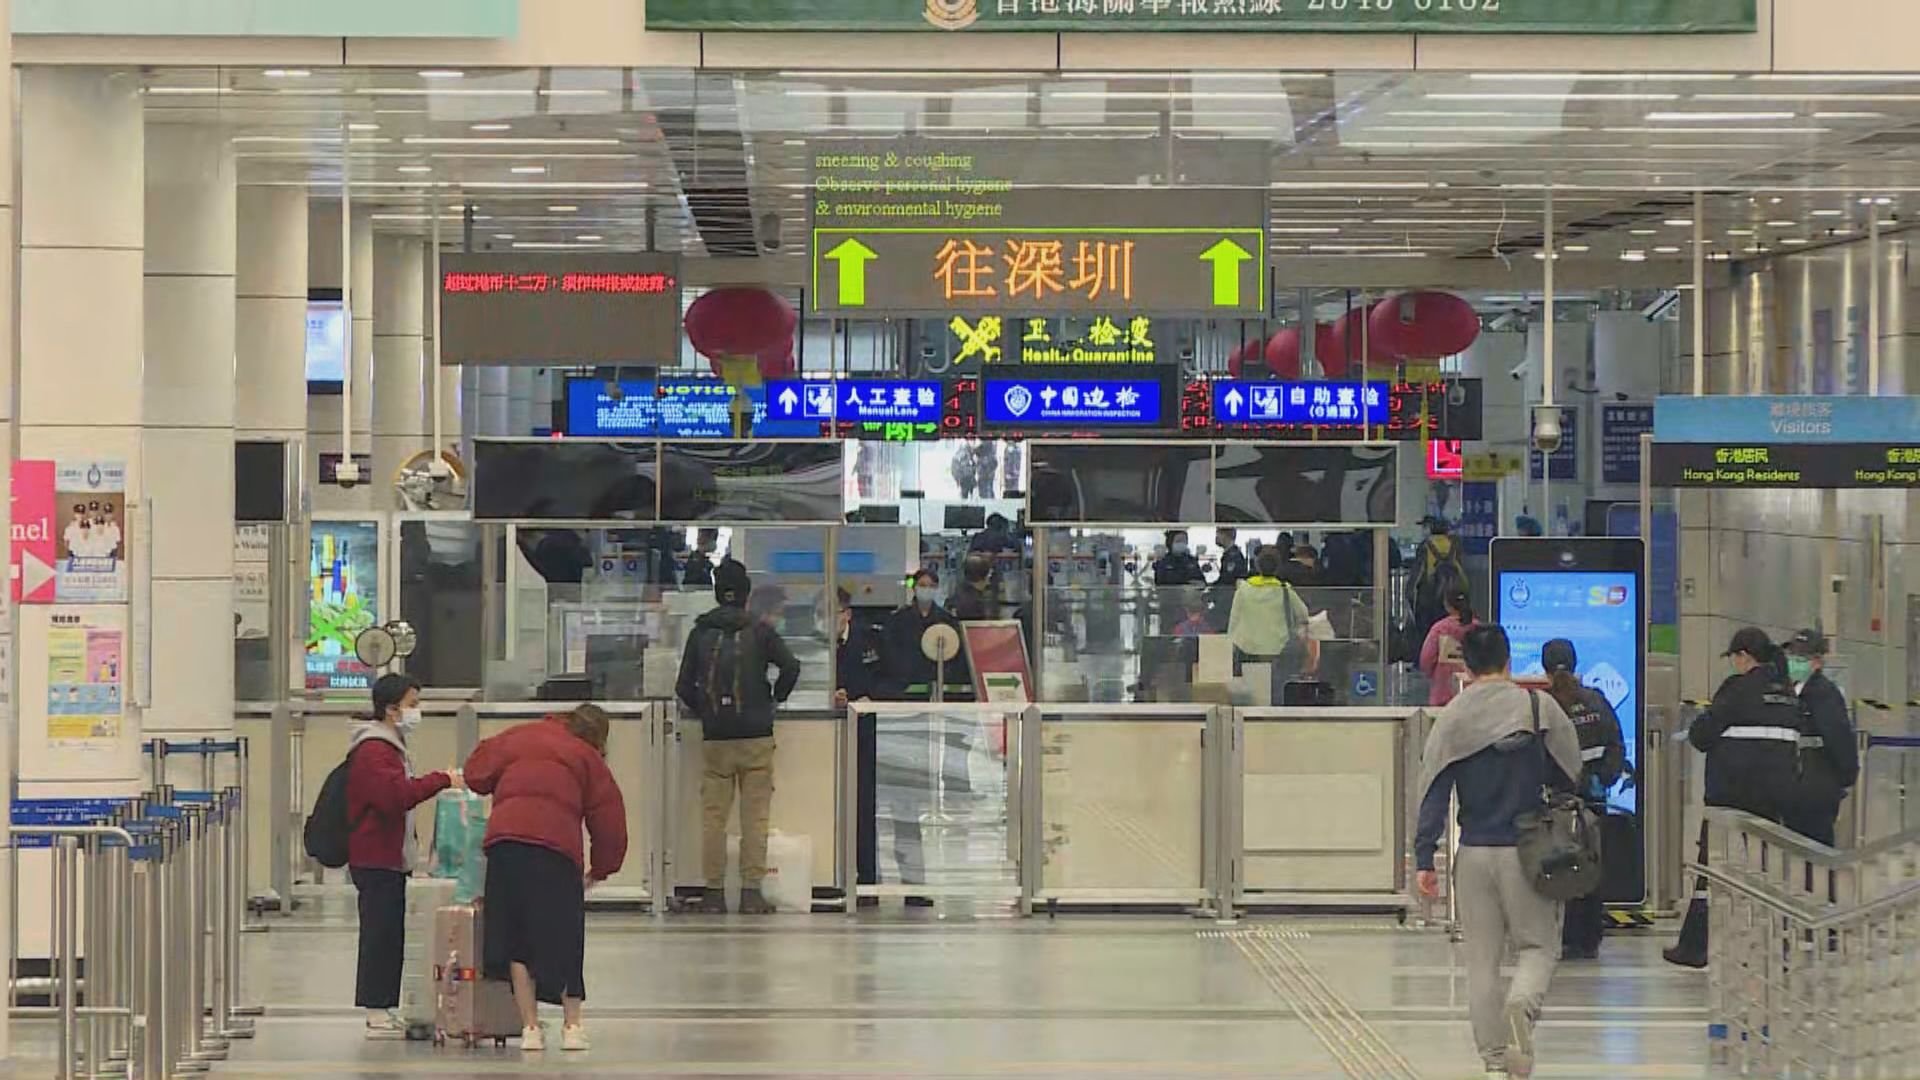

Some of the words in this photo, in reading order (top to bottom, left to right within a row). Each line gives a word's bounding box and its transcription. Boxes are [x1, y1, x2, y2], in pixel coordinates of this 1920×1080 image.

[815, 153, 879, 170] sneezing
[884, 152, 899, 167] &
[905, 152, 972, 171] coughing
[815, 176, 881, 192] Observe
[886, 176, 951, 195] personal
[956, 175, 1012, 195] hygiene
[815, 200, 831, 216] &
[835, 199, 941, 216] environmental
[946, 199, 1002, 219] hygiene
[934, 239, 1135, 300] 往深圳
[1023, 316, 1153, 348] 卫检疫
[1073, 348, 1154, 363] Quarantine
[1040, 386, 1140, 409] 中国边检
[858, 405, 893, 416] Manual
[894, 405, 919, 416] Lane
[1770, 419, 1832, 434] Visitors
[1715, 448, 1768, 464] 香港居民
[1683, 468, 1714, 482] Hong
[1716, 468, 1745, 482] Kong
[1746, 468, 1800, 482] Residents
[1855, 469, 1885, 482] Hong
[1887, 469, 1916, 482] Kong
